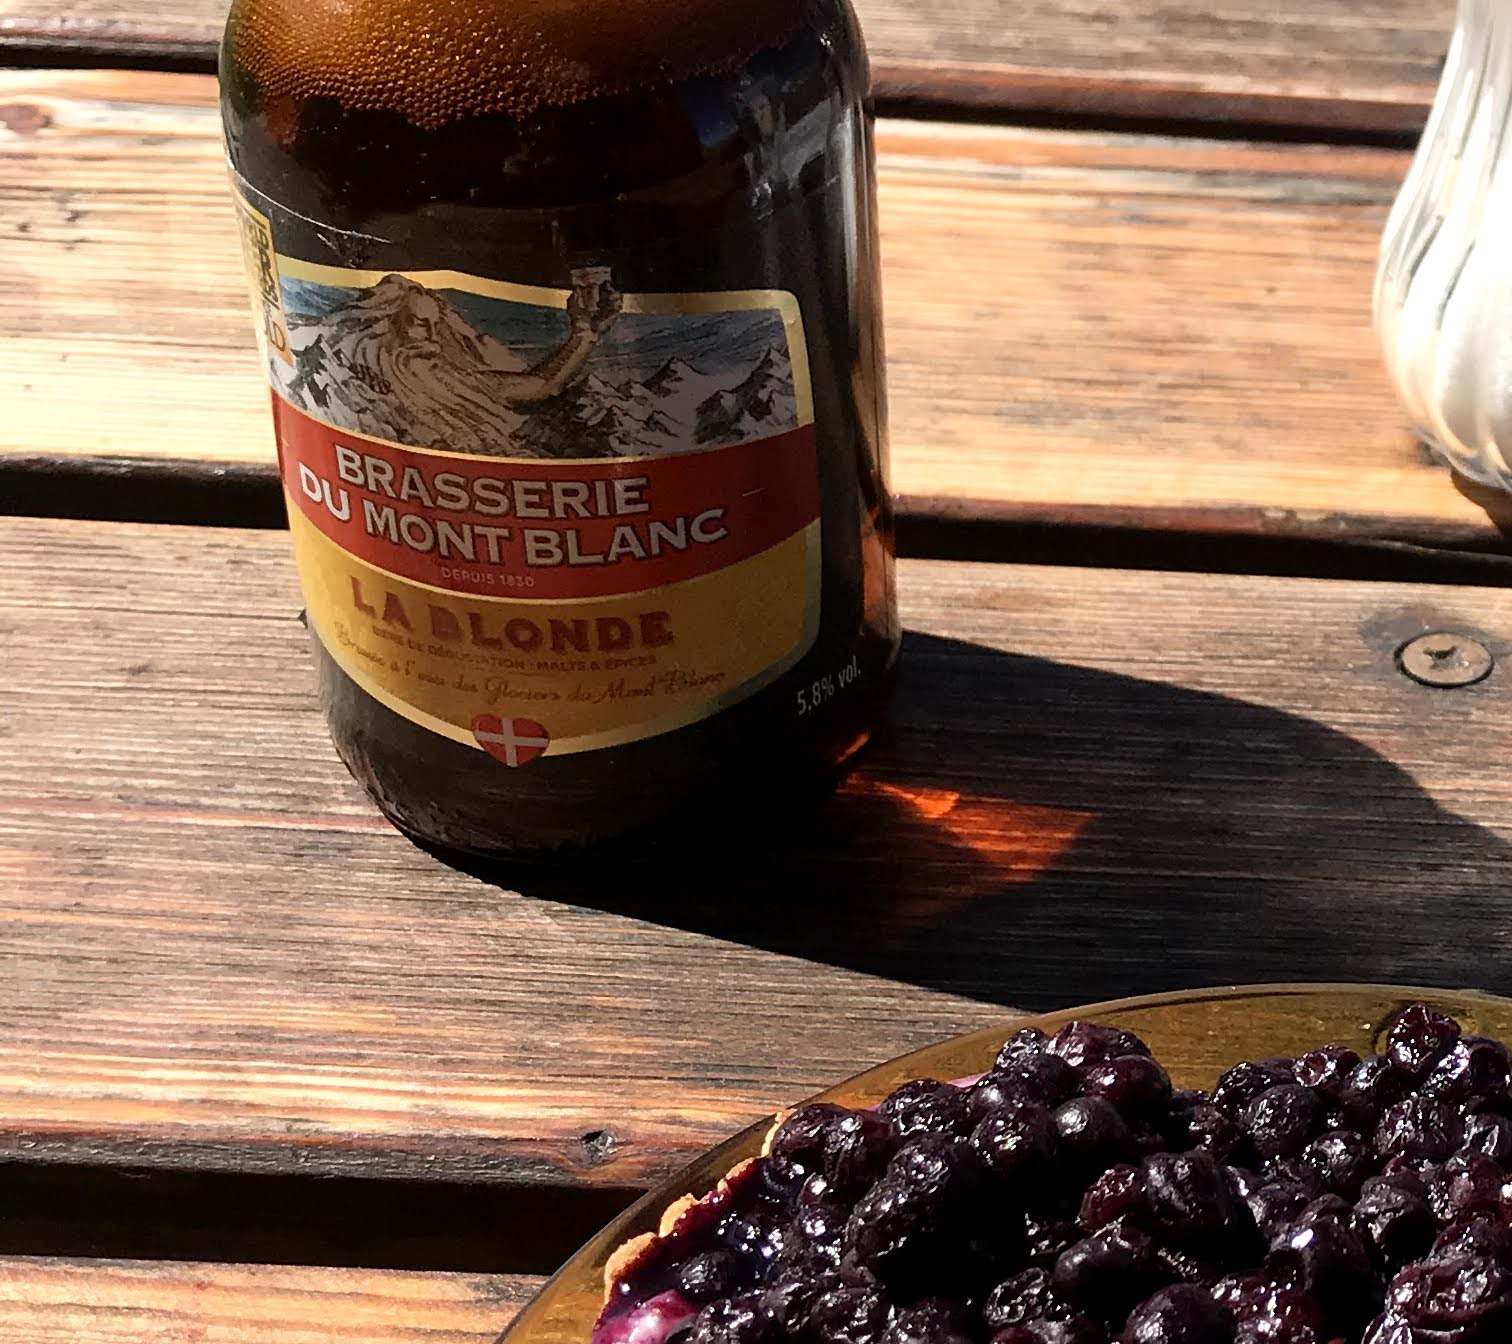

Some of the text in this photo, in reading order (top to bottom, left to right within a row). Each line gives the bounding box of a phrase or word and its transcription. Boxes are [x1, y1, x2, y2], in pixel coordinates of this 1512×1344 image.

[298, 461, 729, 568] DU MONT BLANC
[334, 443, 650, 519] BRASSERIE
[349, 573, 677, 654] LA BLONDE
[441, 566, 536, 588] DEPUIS 1830
[797, 654, 862, 717] 5,8% vol.
